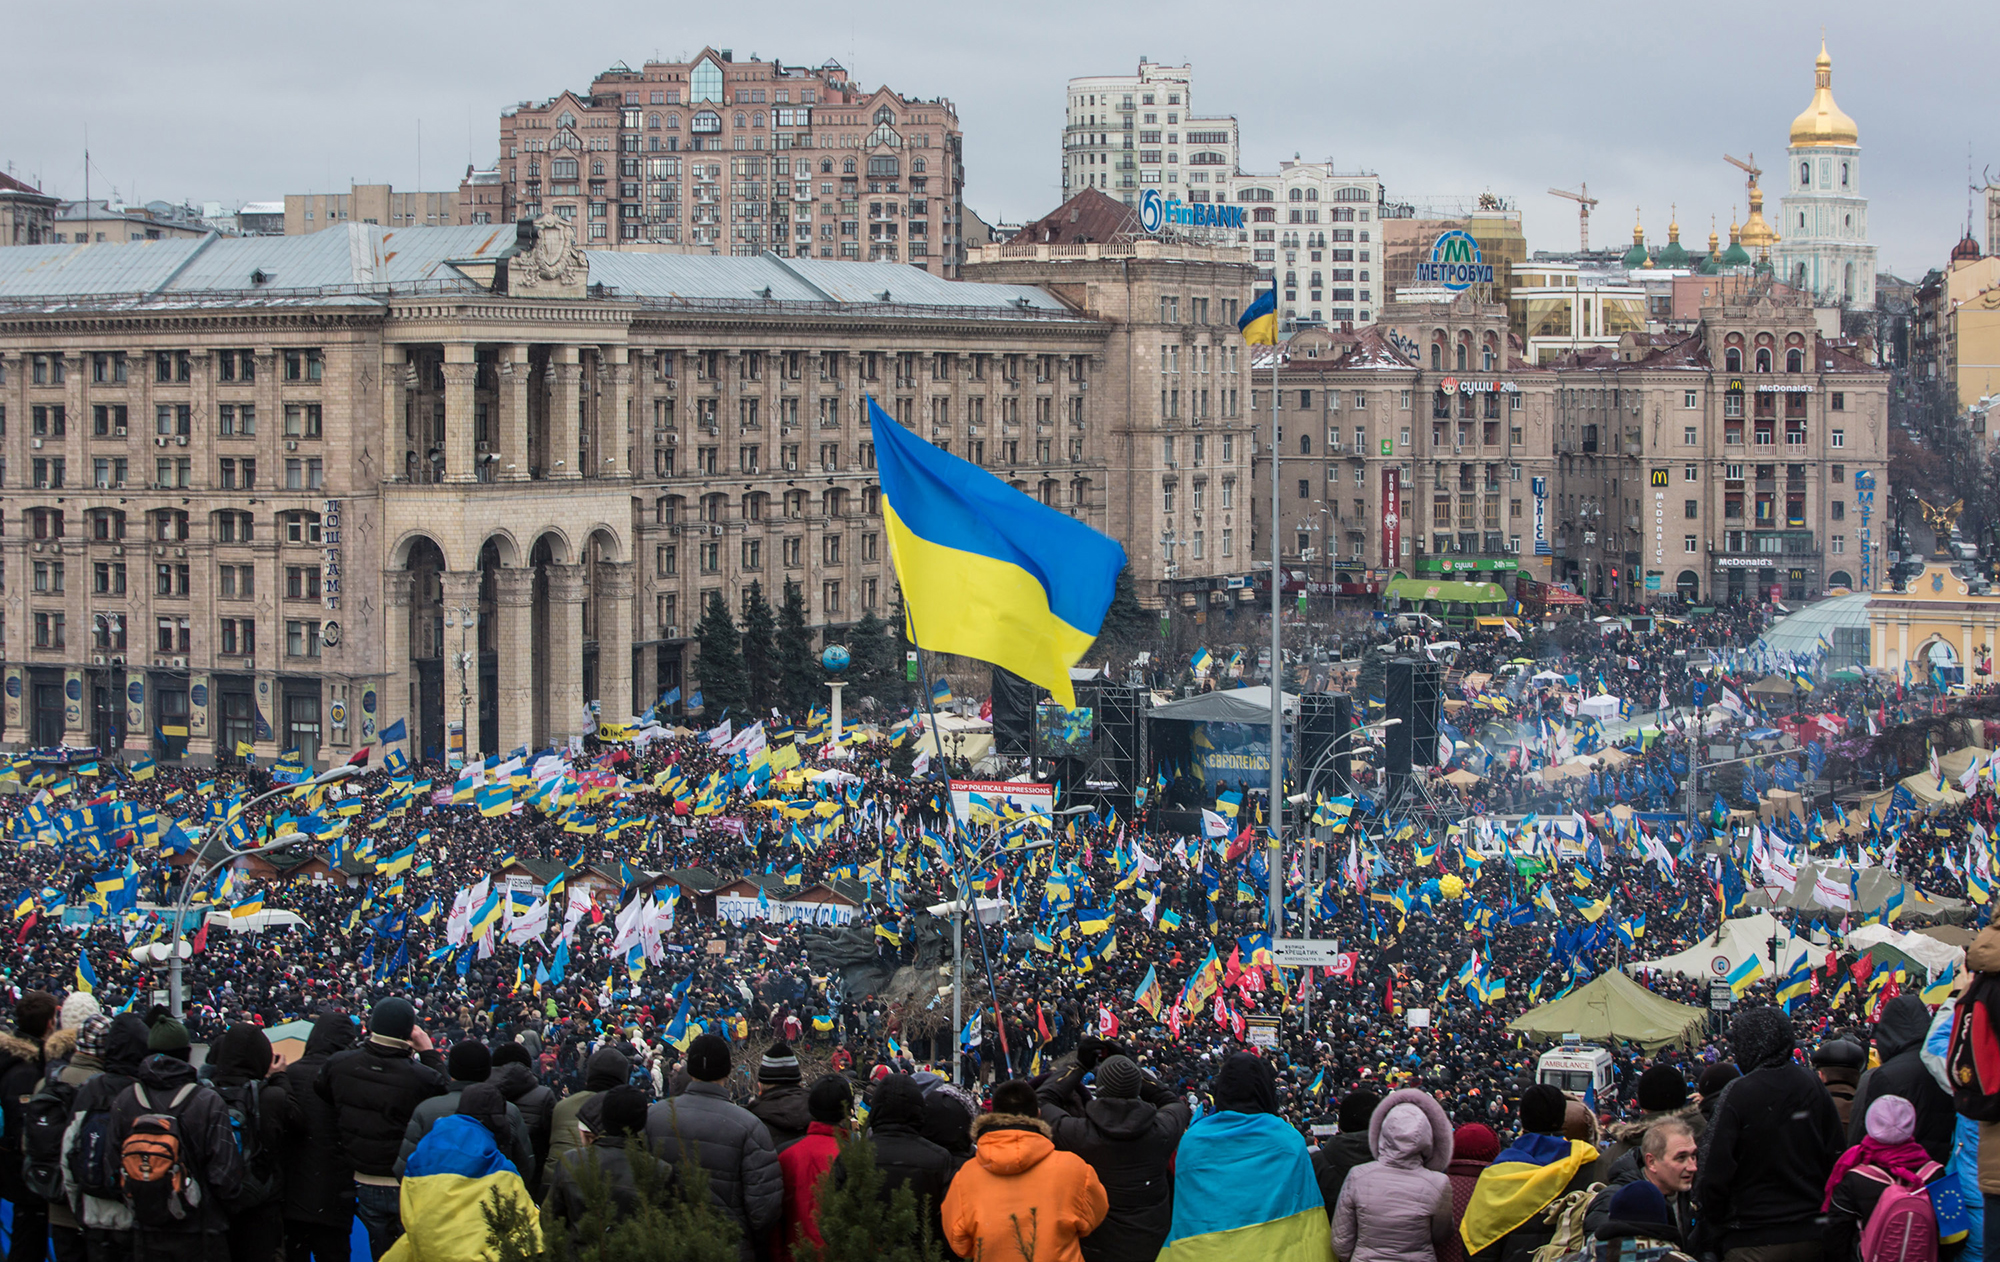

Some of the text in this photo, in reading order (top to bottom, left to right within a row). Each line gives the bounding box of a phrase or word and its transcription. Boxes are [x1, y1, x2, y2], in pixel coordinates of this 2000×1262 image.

[1165, 199, 1245, 229] FinBANK
[1417, 263, 1494, 283] МЕТРОБУД
[1759, 384, 1813, 392] McDonald's
[1655, 492, 1664, 564] McDonald's
[325, 500, 340, 609] ПОШТАМТ
[1718, 558, 1773, 566] McDonald's
[968, 784, 1002, 792] POLITICAL
[1003, 785, 1050, 794] REPRESSIONS
[1544, 1060, 1589, 1069] AMBULANCE
